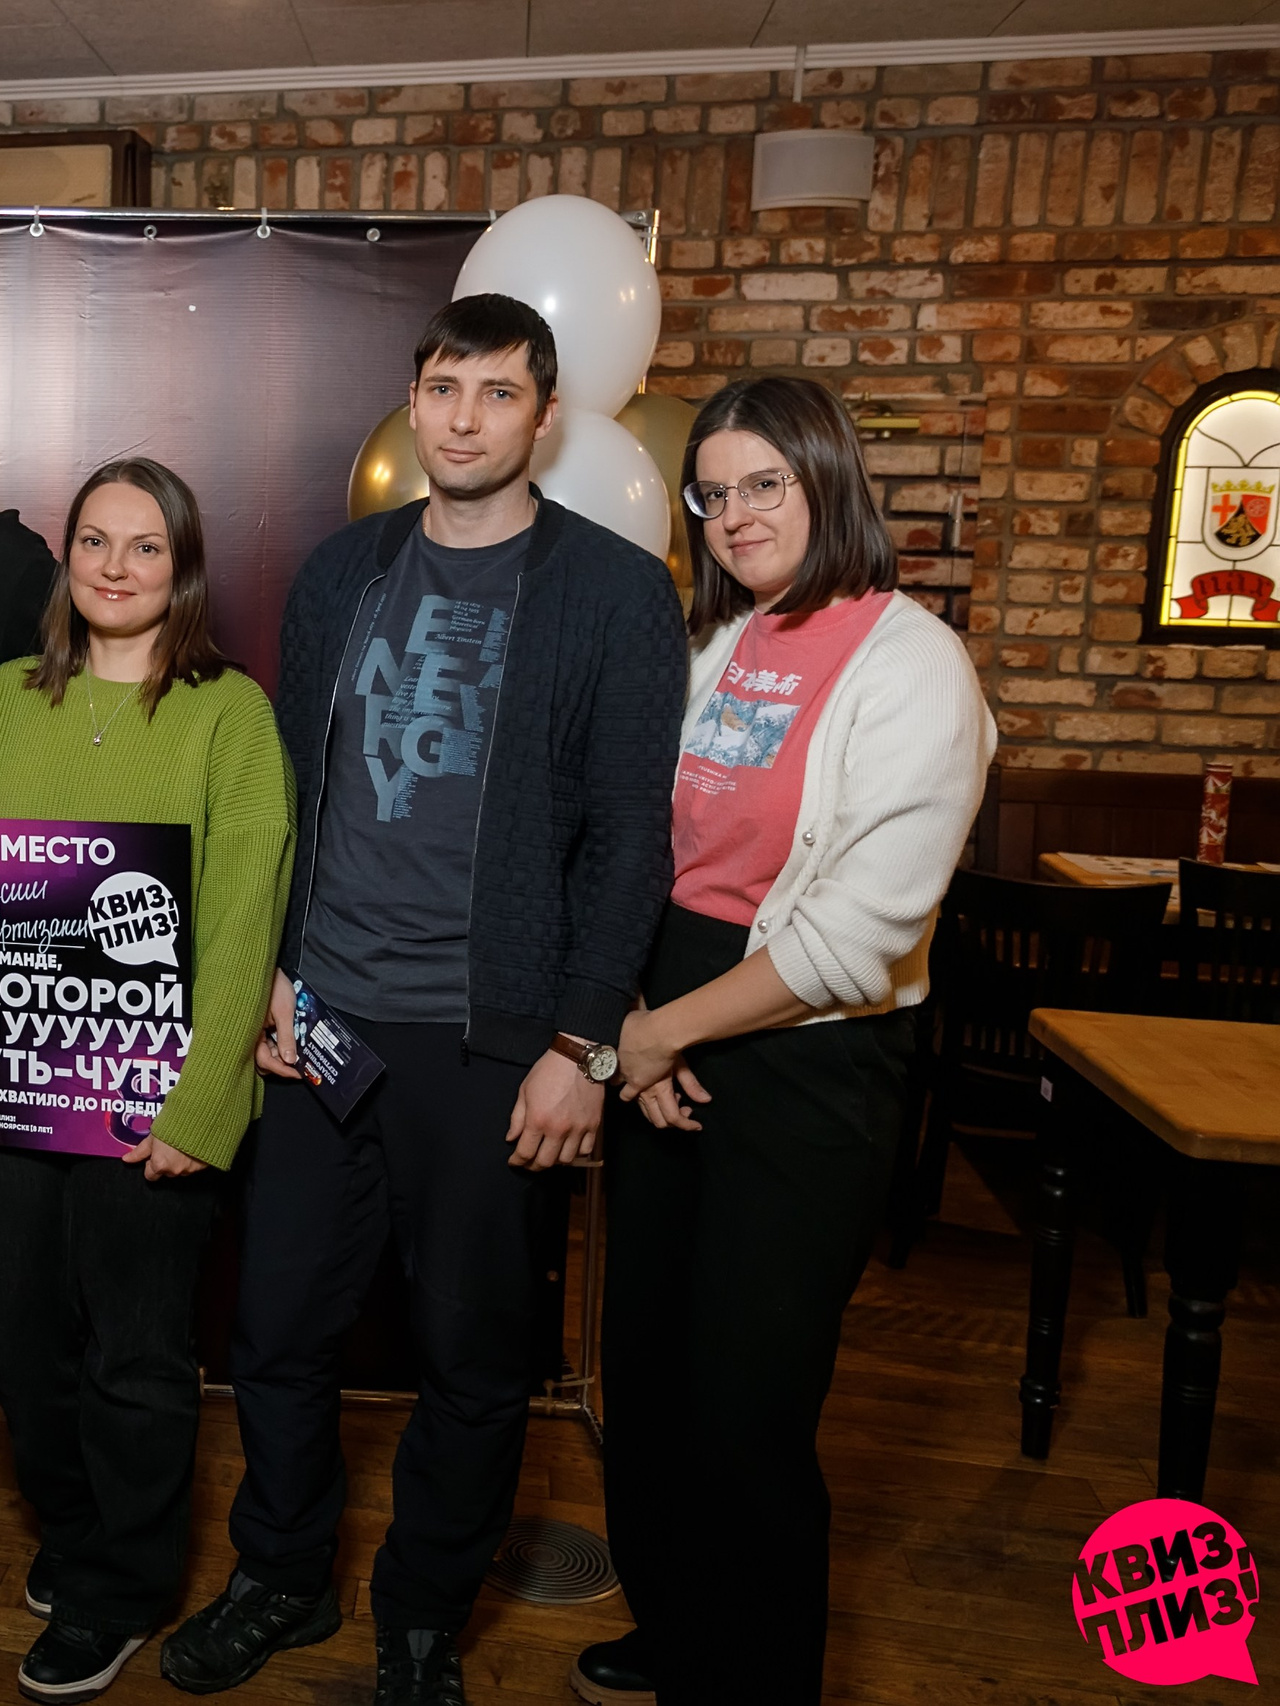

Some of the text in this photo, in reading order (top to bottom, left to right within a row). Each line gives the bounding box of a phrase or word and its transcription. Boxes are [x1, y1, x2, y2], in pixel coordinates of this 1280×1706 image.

[0, 834, 116, 866] МЕСТО
[89, 884, 175, 923] КВИЗ,
[92, 910, 179, 950] ПЛИЗ!
[73, 1096, 98, 1112] ДО
